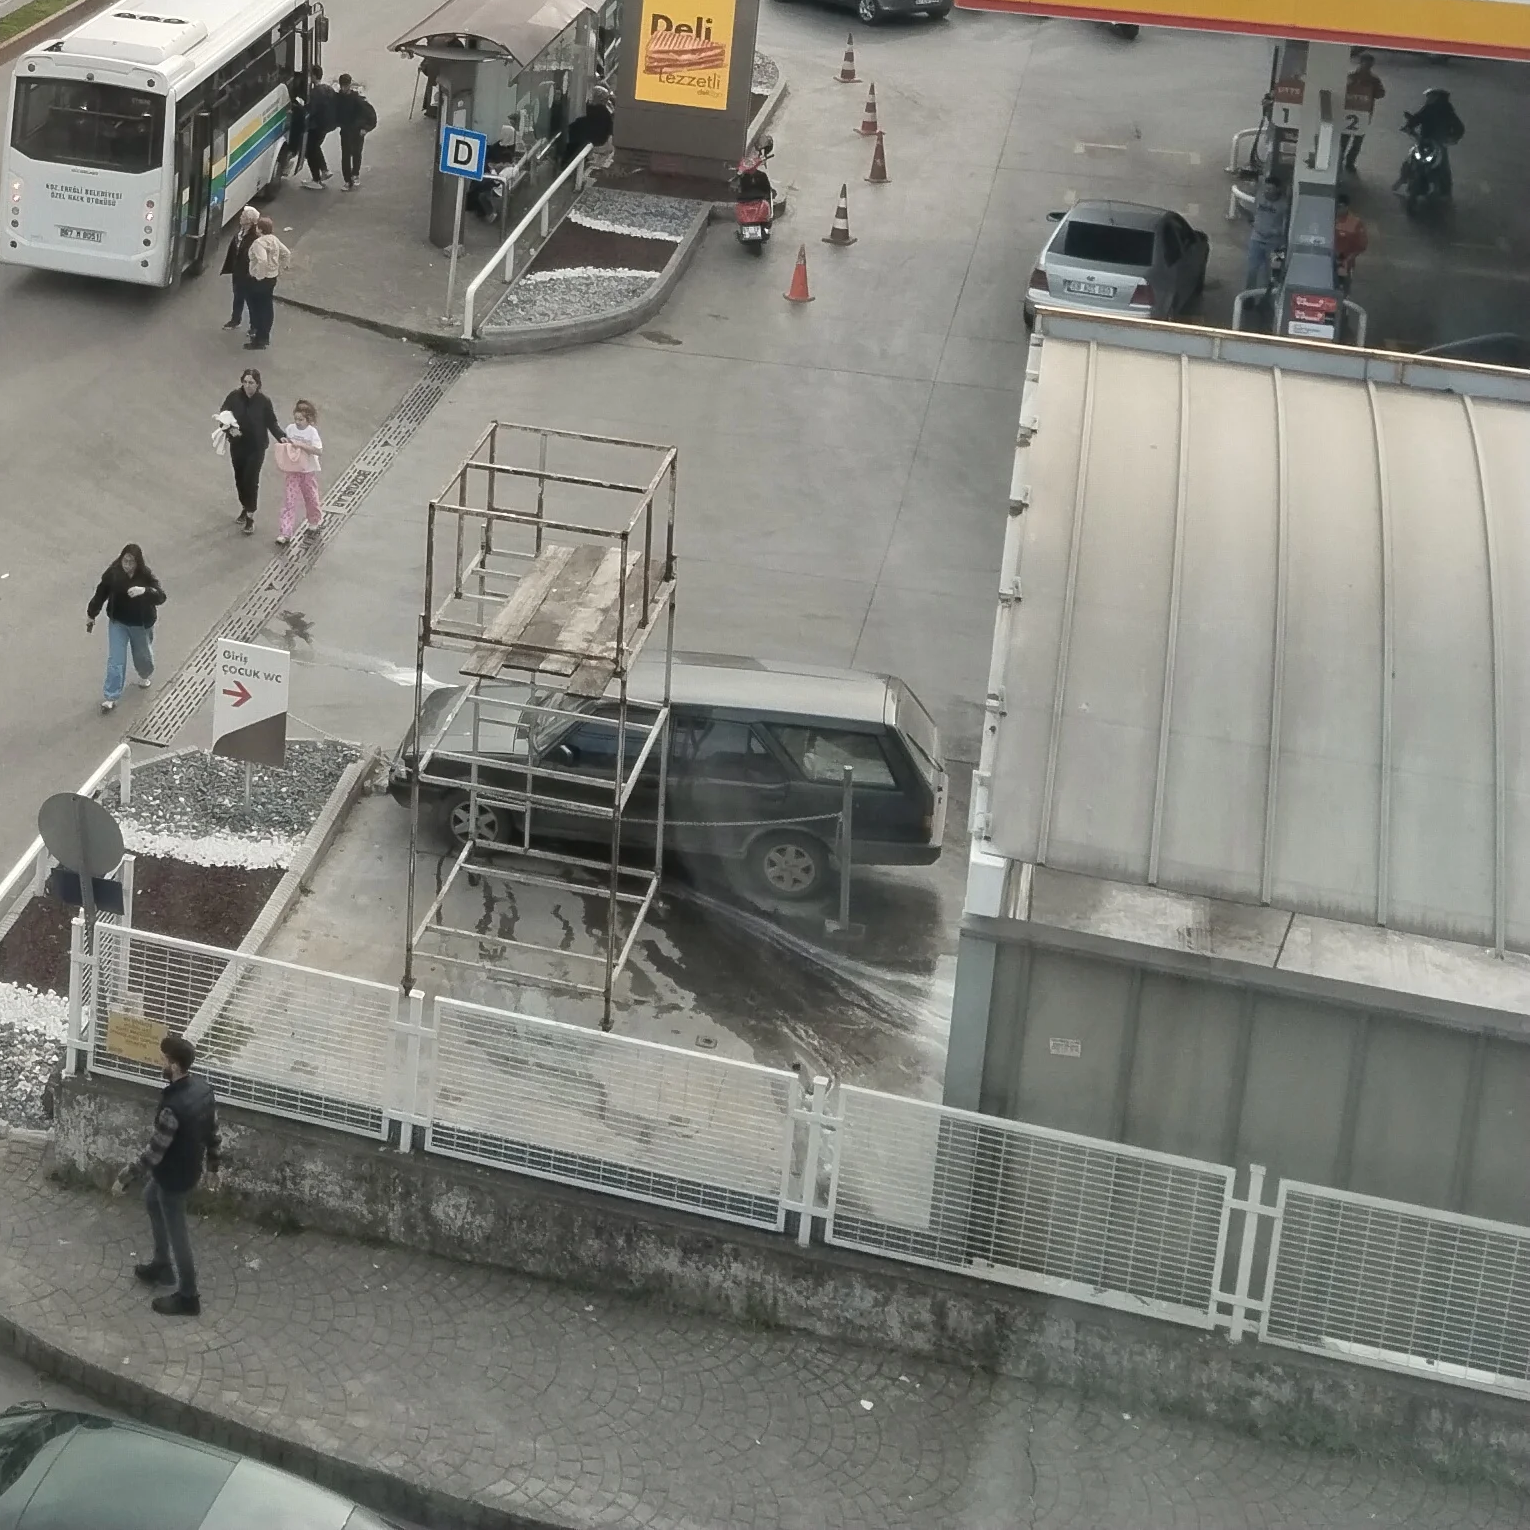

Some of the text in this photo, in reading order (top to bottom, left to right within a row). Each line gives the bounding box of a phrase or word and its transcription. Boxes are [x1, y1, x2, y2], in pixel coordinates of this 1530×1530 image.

[651, 13, 713, 43] Deli
[1282, 107, 1290, 123] 1
[1345, 114, 1360, 130] 2
[453, 140, 472, 166] D
[222, 650, 248, 665] Giriş
[222, 664, 282, 683] ÇOCUK WC
